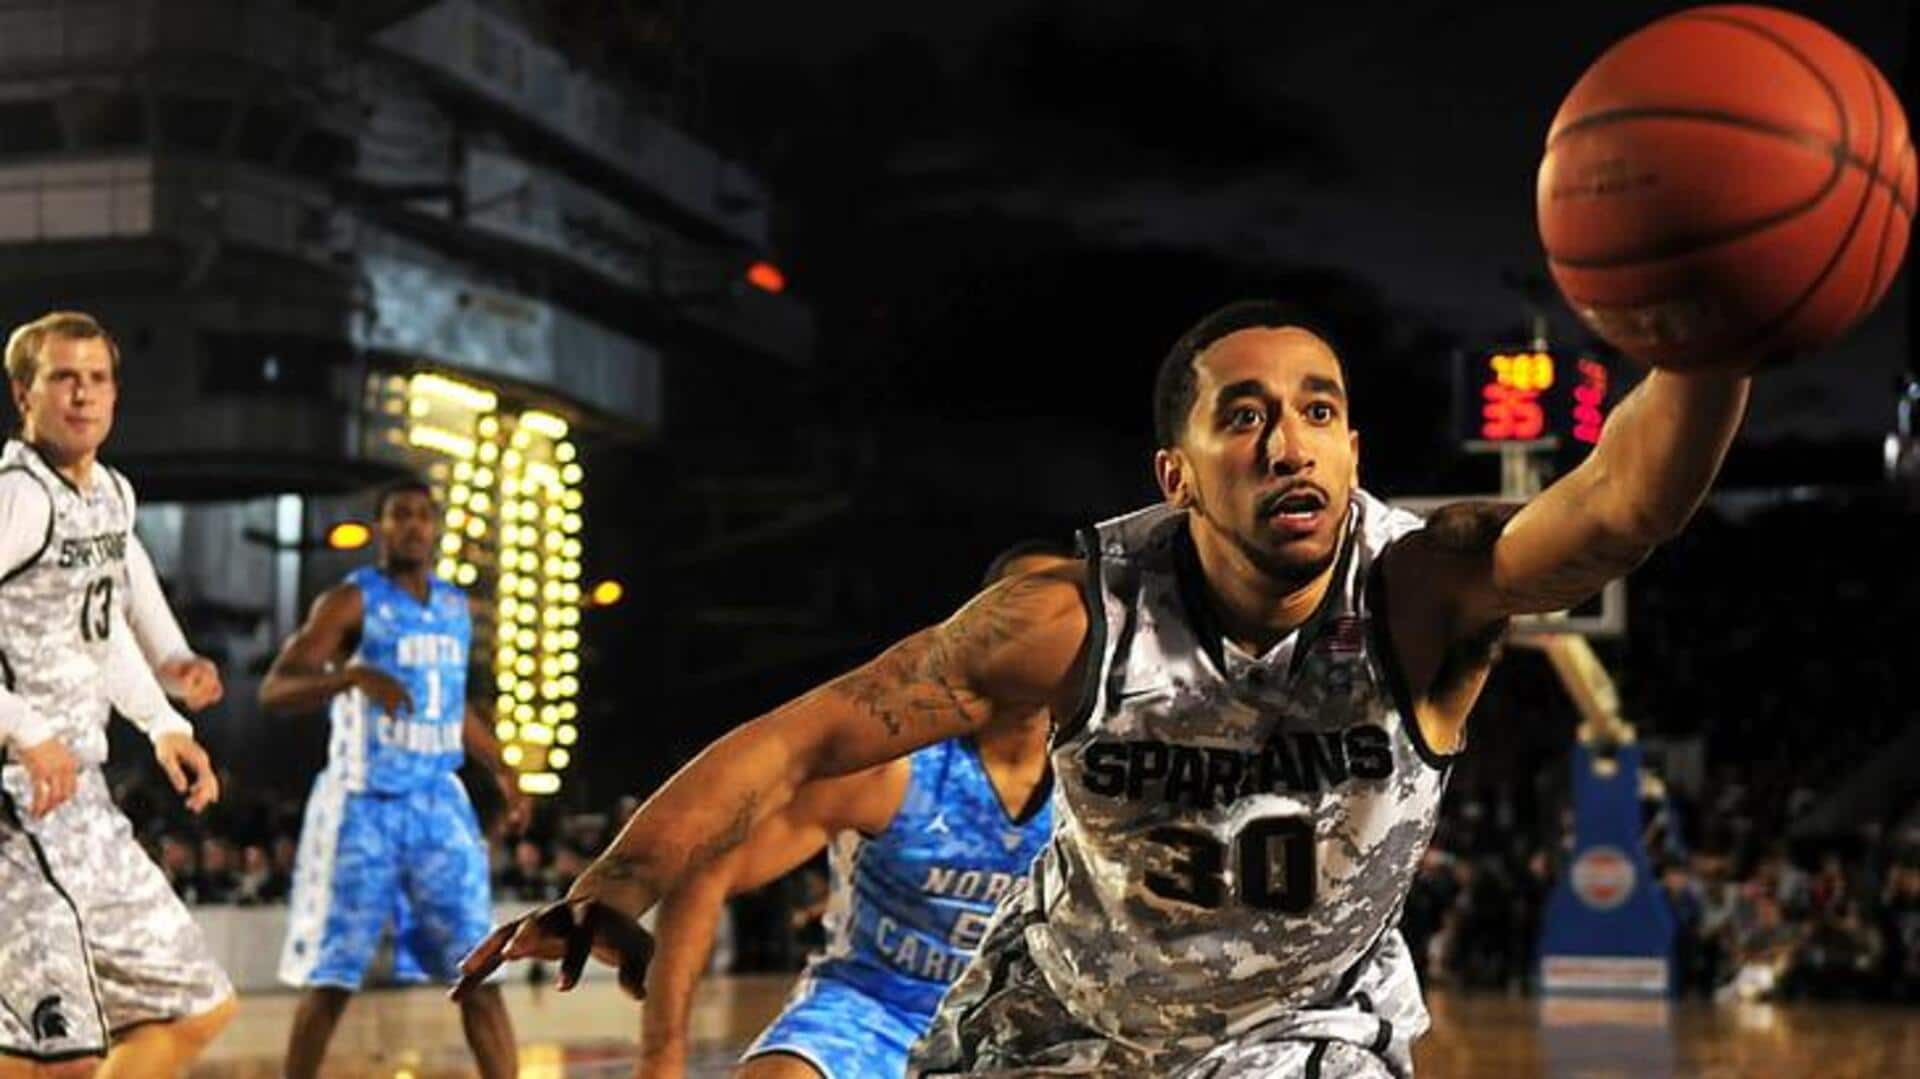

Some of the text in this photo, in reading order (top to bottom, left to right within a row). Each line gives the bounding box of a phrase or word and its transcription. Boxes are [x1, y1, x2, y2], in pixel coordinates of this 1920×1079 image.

[80, 576, 113, 642] 13
[424, 668, 441, 720] 1
[1082, 724, 1395, 808] SPARANS
[1141, 816, 1318, 915] 30
